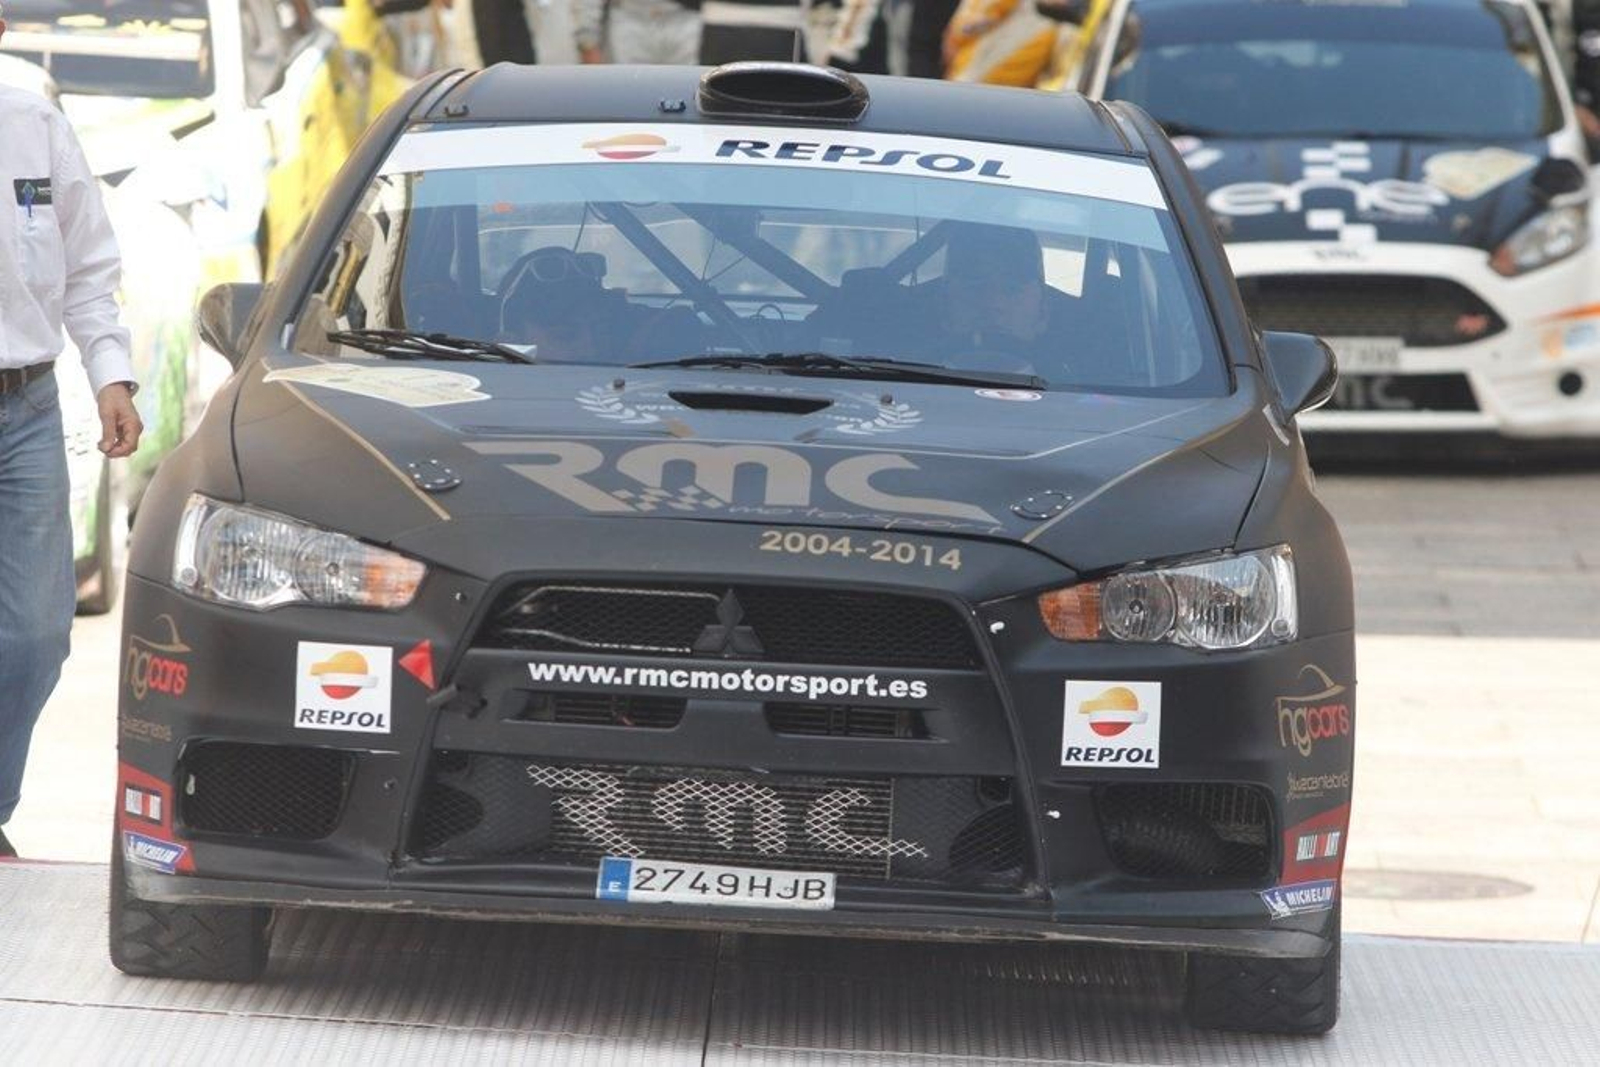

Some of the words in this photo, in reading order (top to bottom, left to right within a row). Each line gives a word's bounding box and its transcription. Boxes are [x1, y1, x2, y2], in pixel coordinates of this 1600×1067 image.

[715, 139, 1011, 179] REPSOL
[759, 530, 961, 571] 2004-2014
[528, 662, 928, 699] www.rmcmotorsport.es
[299, 708, 386, 728] REPSOL
[1065, 747, 1155, 763] REPSOL
[1286, 886, 1333, 907] MICHELIN
